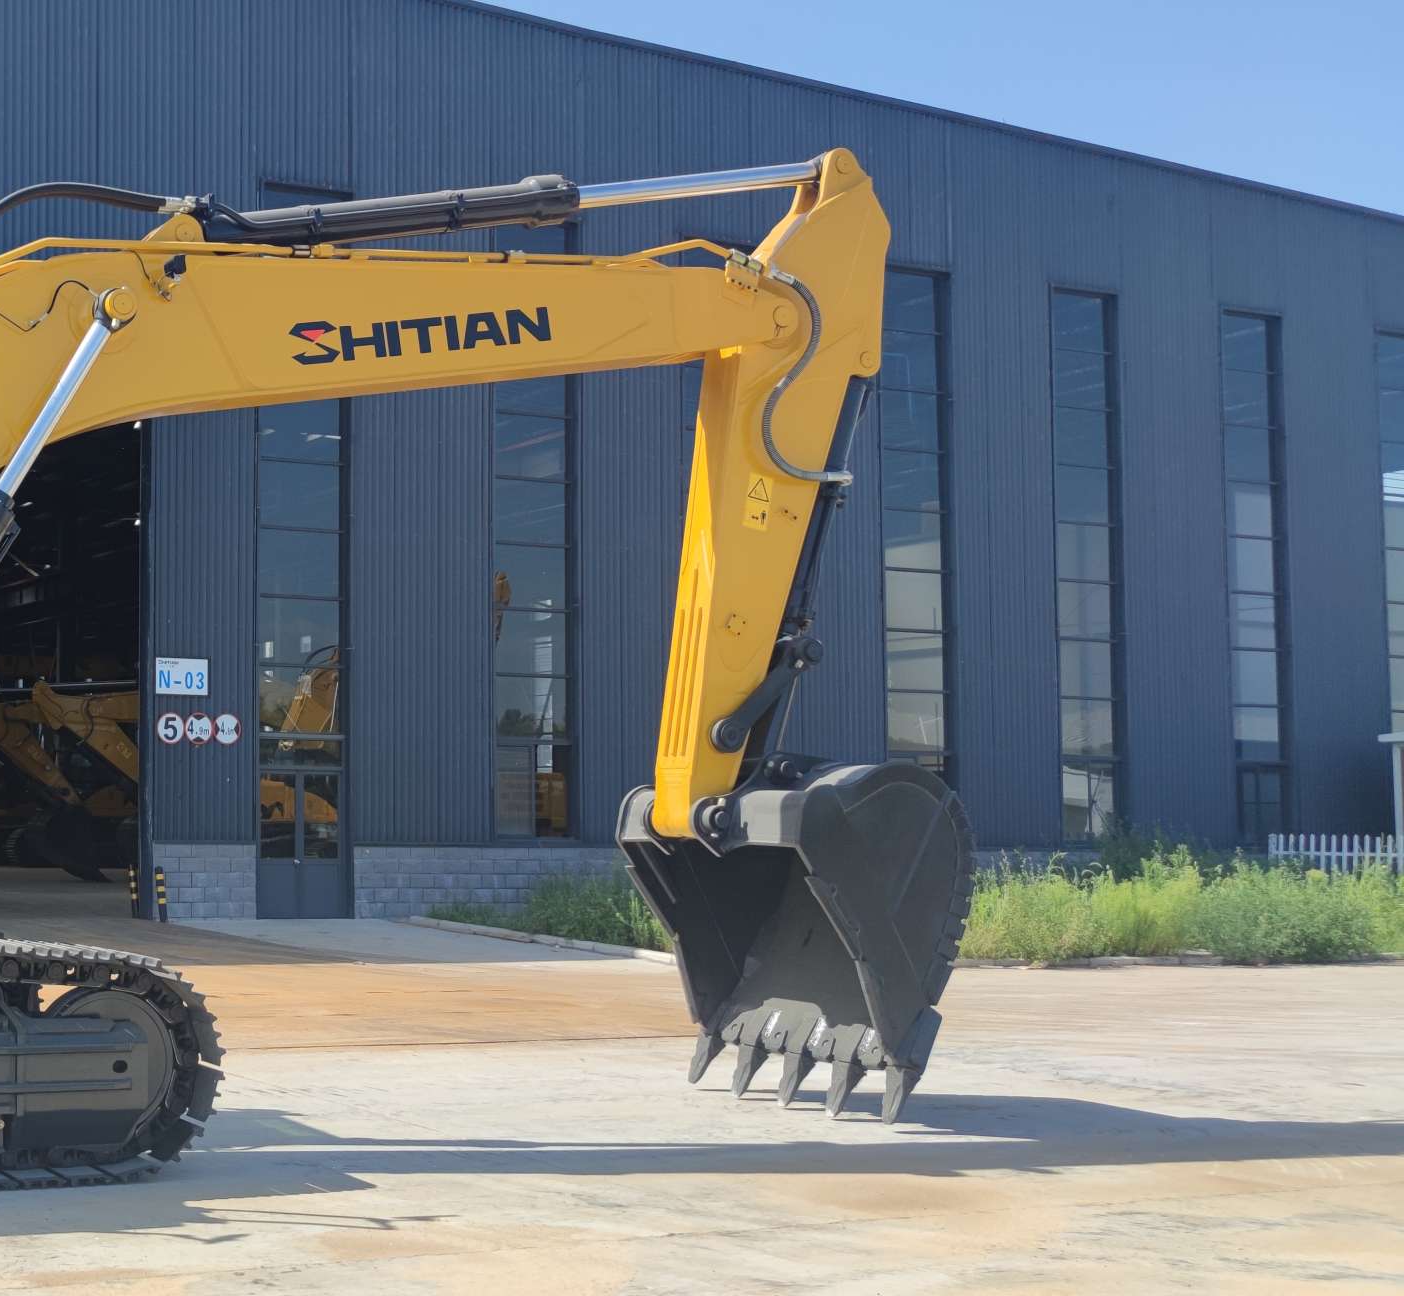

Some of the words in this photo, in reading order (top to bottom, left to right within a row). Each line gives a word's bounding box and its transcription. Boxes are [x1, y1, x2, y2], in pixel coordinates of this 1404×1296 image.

[289, 306, 552, 365] SHITIAN
[158, 670, 204, 690] N-03
[163, 716, 178, 741] 5
